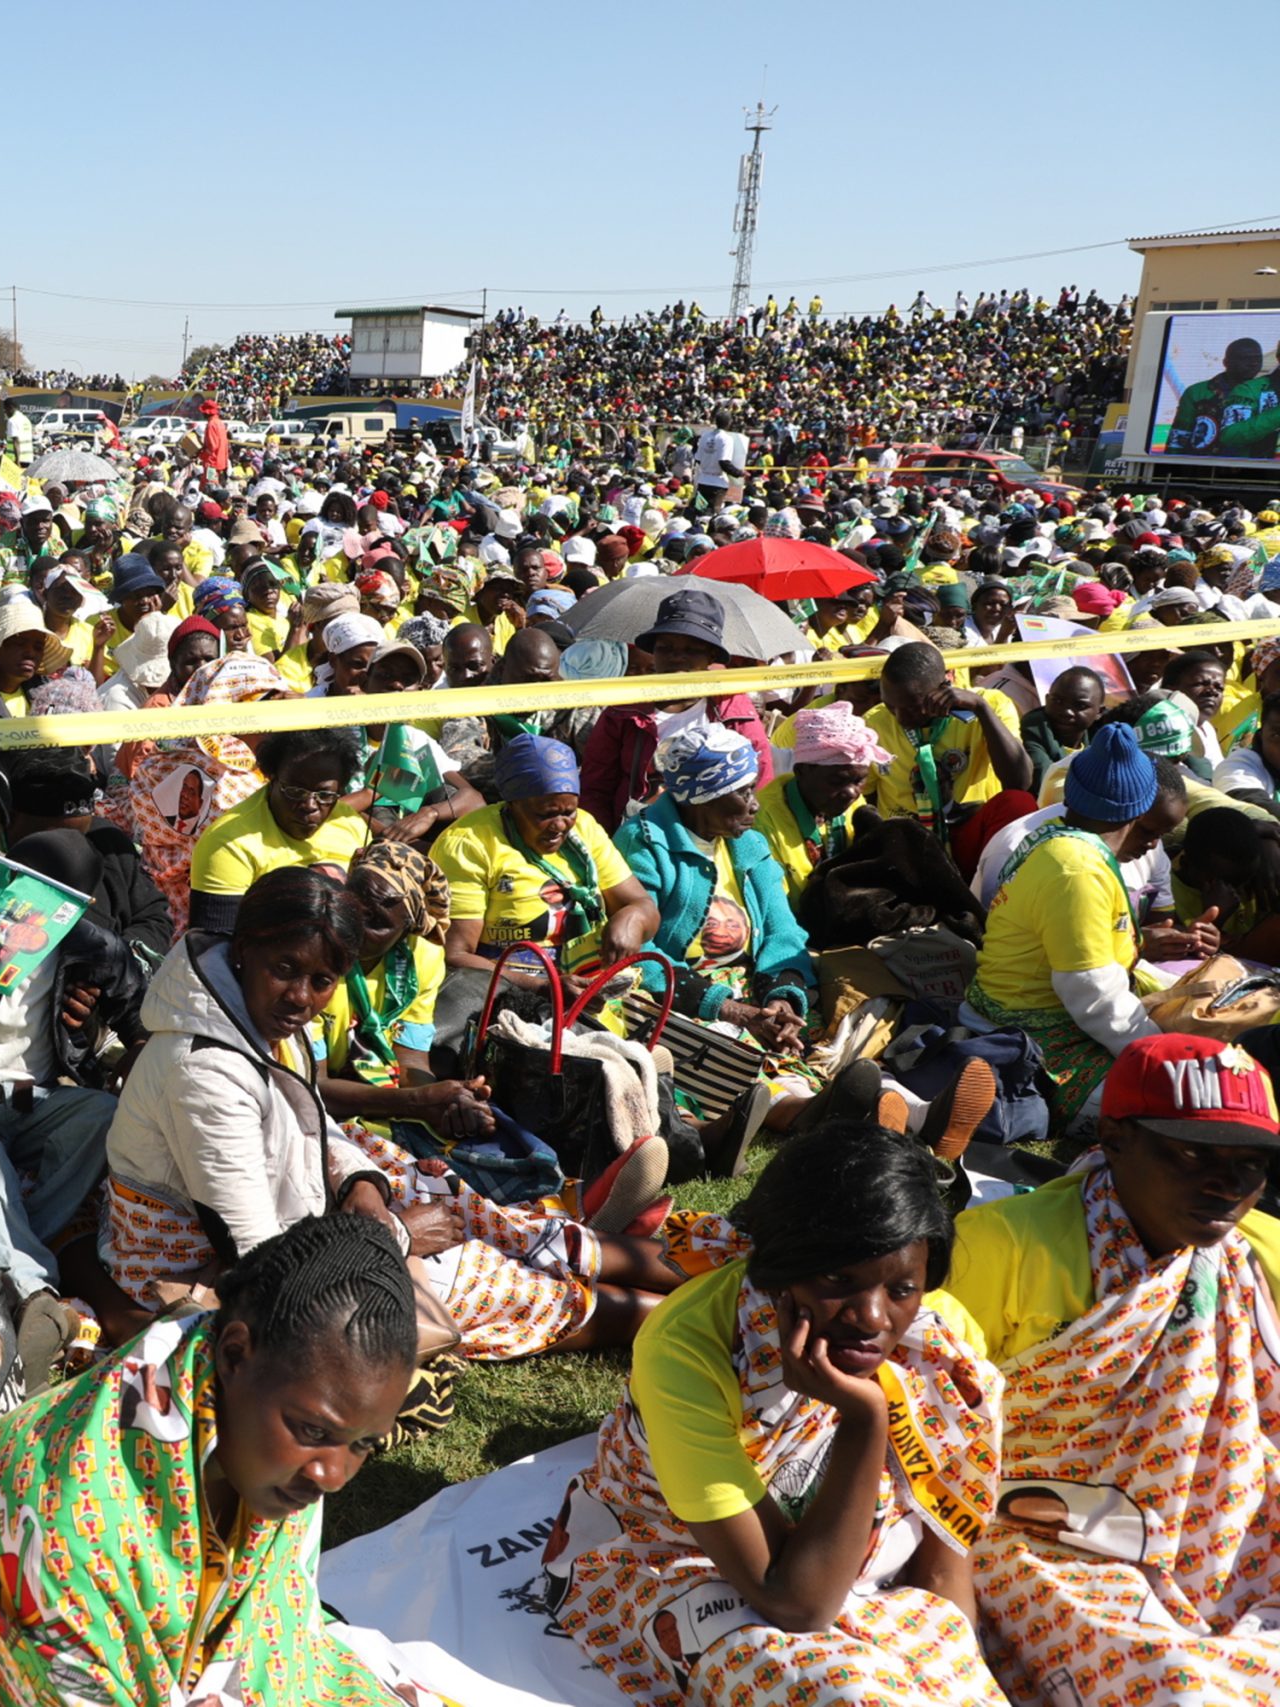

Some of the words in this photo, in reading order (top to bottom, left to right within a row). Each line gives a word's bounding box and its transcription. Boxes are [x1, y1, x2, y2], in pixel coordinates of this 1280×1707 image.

[487, 927, 532, 941] VOICE
[894, 1424, 934, 1481] ZANU
[931, 1494, 958, 1520] PF
[467, 1516, 556, 1569] ZAN
[694, 1597, 736, 1624] ZANU
